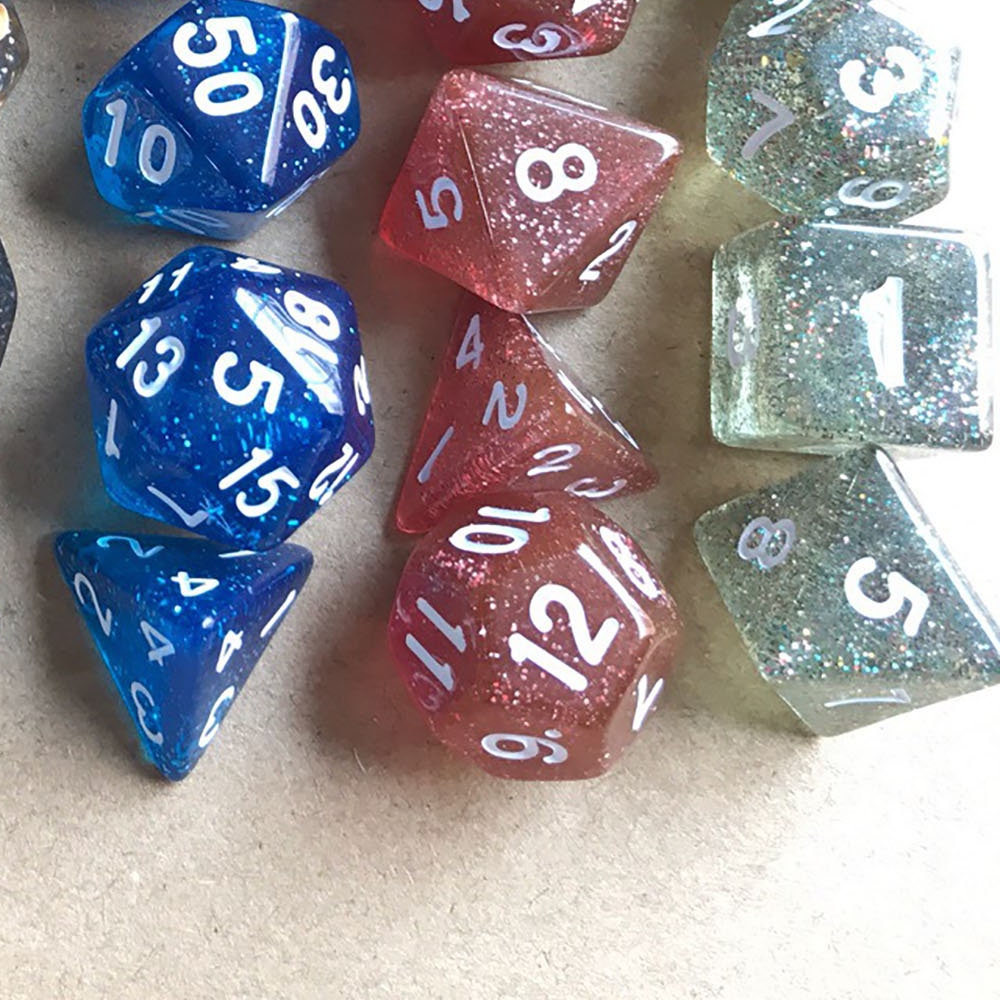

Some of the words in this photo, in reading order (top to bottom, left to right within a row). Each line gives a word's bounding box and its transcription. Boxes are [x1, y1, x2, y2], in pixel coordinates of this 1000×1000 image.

[172, 16, 264, 116] 50
[292, 44, 351, 150] 30
[839, 46, 921, 113] 3
[105, 99, 177, 186] 10
[741, 90, 794, 160] 7
[415, 176, 463, 230] 5
[515, 142, 598, 203] 8
[138, 261, 194, 304] 11
[578, 220, 637, 281] 2
[116, 316, 185, 398] 13
[456, 313, 484, 370] 4
[859, 276, 906, 390] 1
[212, 350, 285, 414] 5
[482, 381, 528, 430] 2
[218, 446, 300, 518] 15
[449, 506, 550, 555] 10
[599, 525, 661, 600] 8
[737, 516, 797, 569] 8
[74, 572, 113, 637] 2
[171, 571, 220, 597] 4
[844, 556, 930, 638] 5
[140, 620, 176, 667] 4
[215, 629, 244, 673] 4
[405, 597, 467, 691] 11
[508, 583, 620, 691] 12
[130, 681, 165, 745] 3
